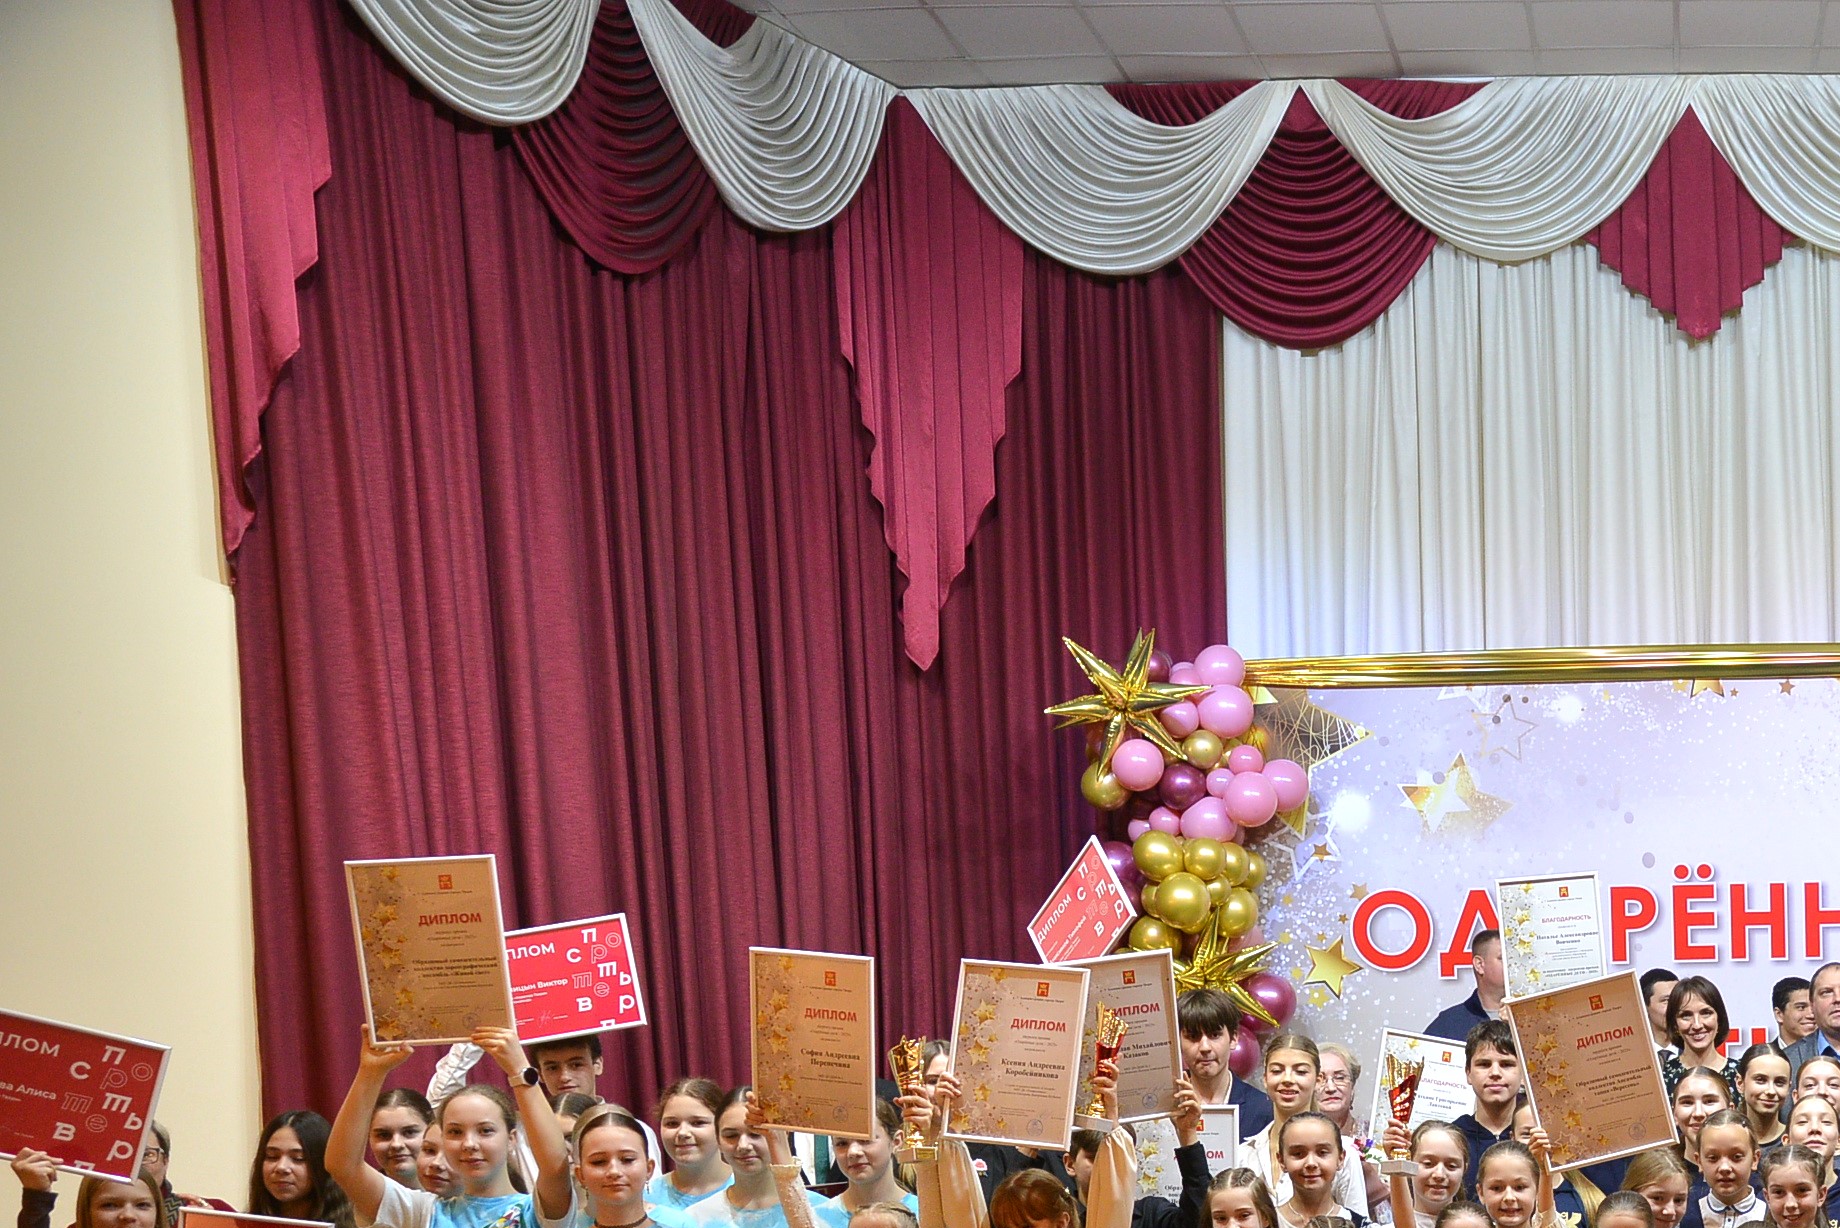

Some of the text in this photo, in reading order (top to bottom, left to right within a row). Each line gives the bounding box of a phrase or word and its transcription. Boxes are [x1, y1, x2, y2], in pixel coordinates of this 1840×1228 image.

[419, 913, 482, 927] ДИПЛОМ
[1037, 894, 1072, 944] ДИПЛОМ
[1541, 914, 1592, 924] БЛАГОДАРНОСТЬ
[506, 943, 555, 961] ПЛОМ
[537, 979, 568, 989] Виктор
[805, 1007, 858, 1022] ДИПЛОМ
[1106, 1002, 1160, 1017] ИПЛОМ
[1011, 1018, 1066, 1032] ДИПЛОМ
[0, 1031, 61, 1057] ЛОМ
[1576, 1025, 1634, 1050] ДИПЛОМ
[1421, 1077, 1467, 1090] ЛАГОДАРНОСТЬ
[16, 1083, 57, 1101] Алиса
